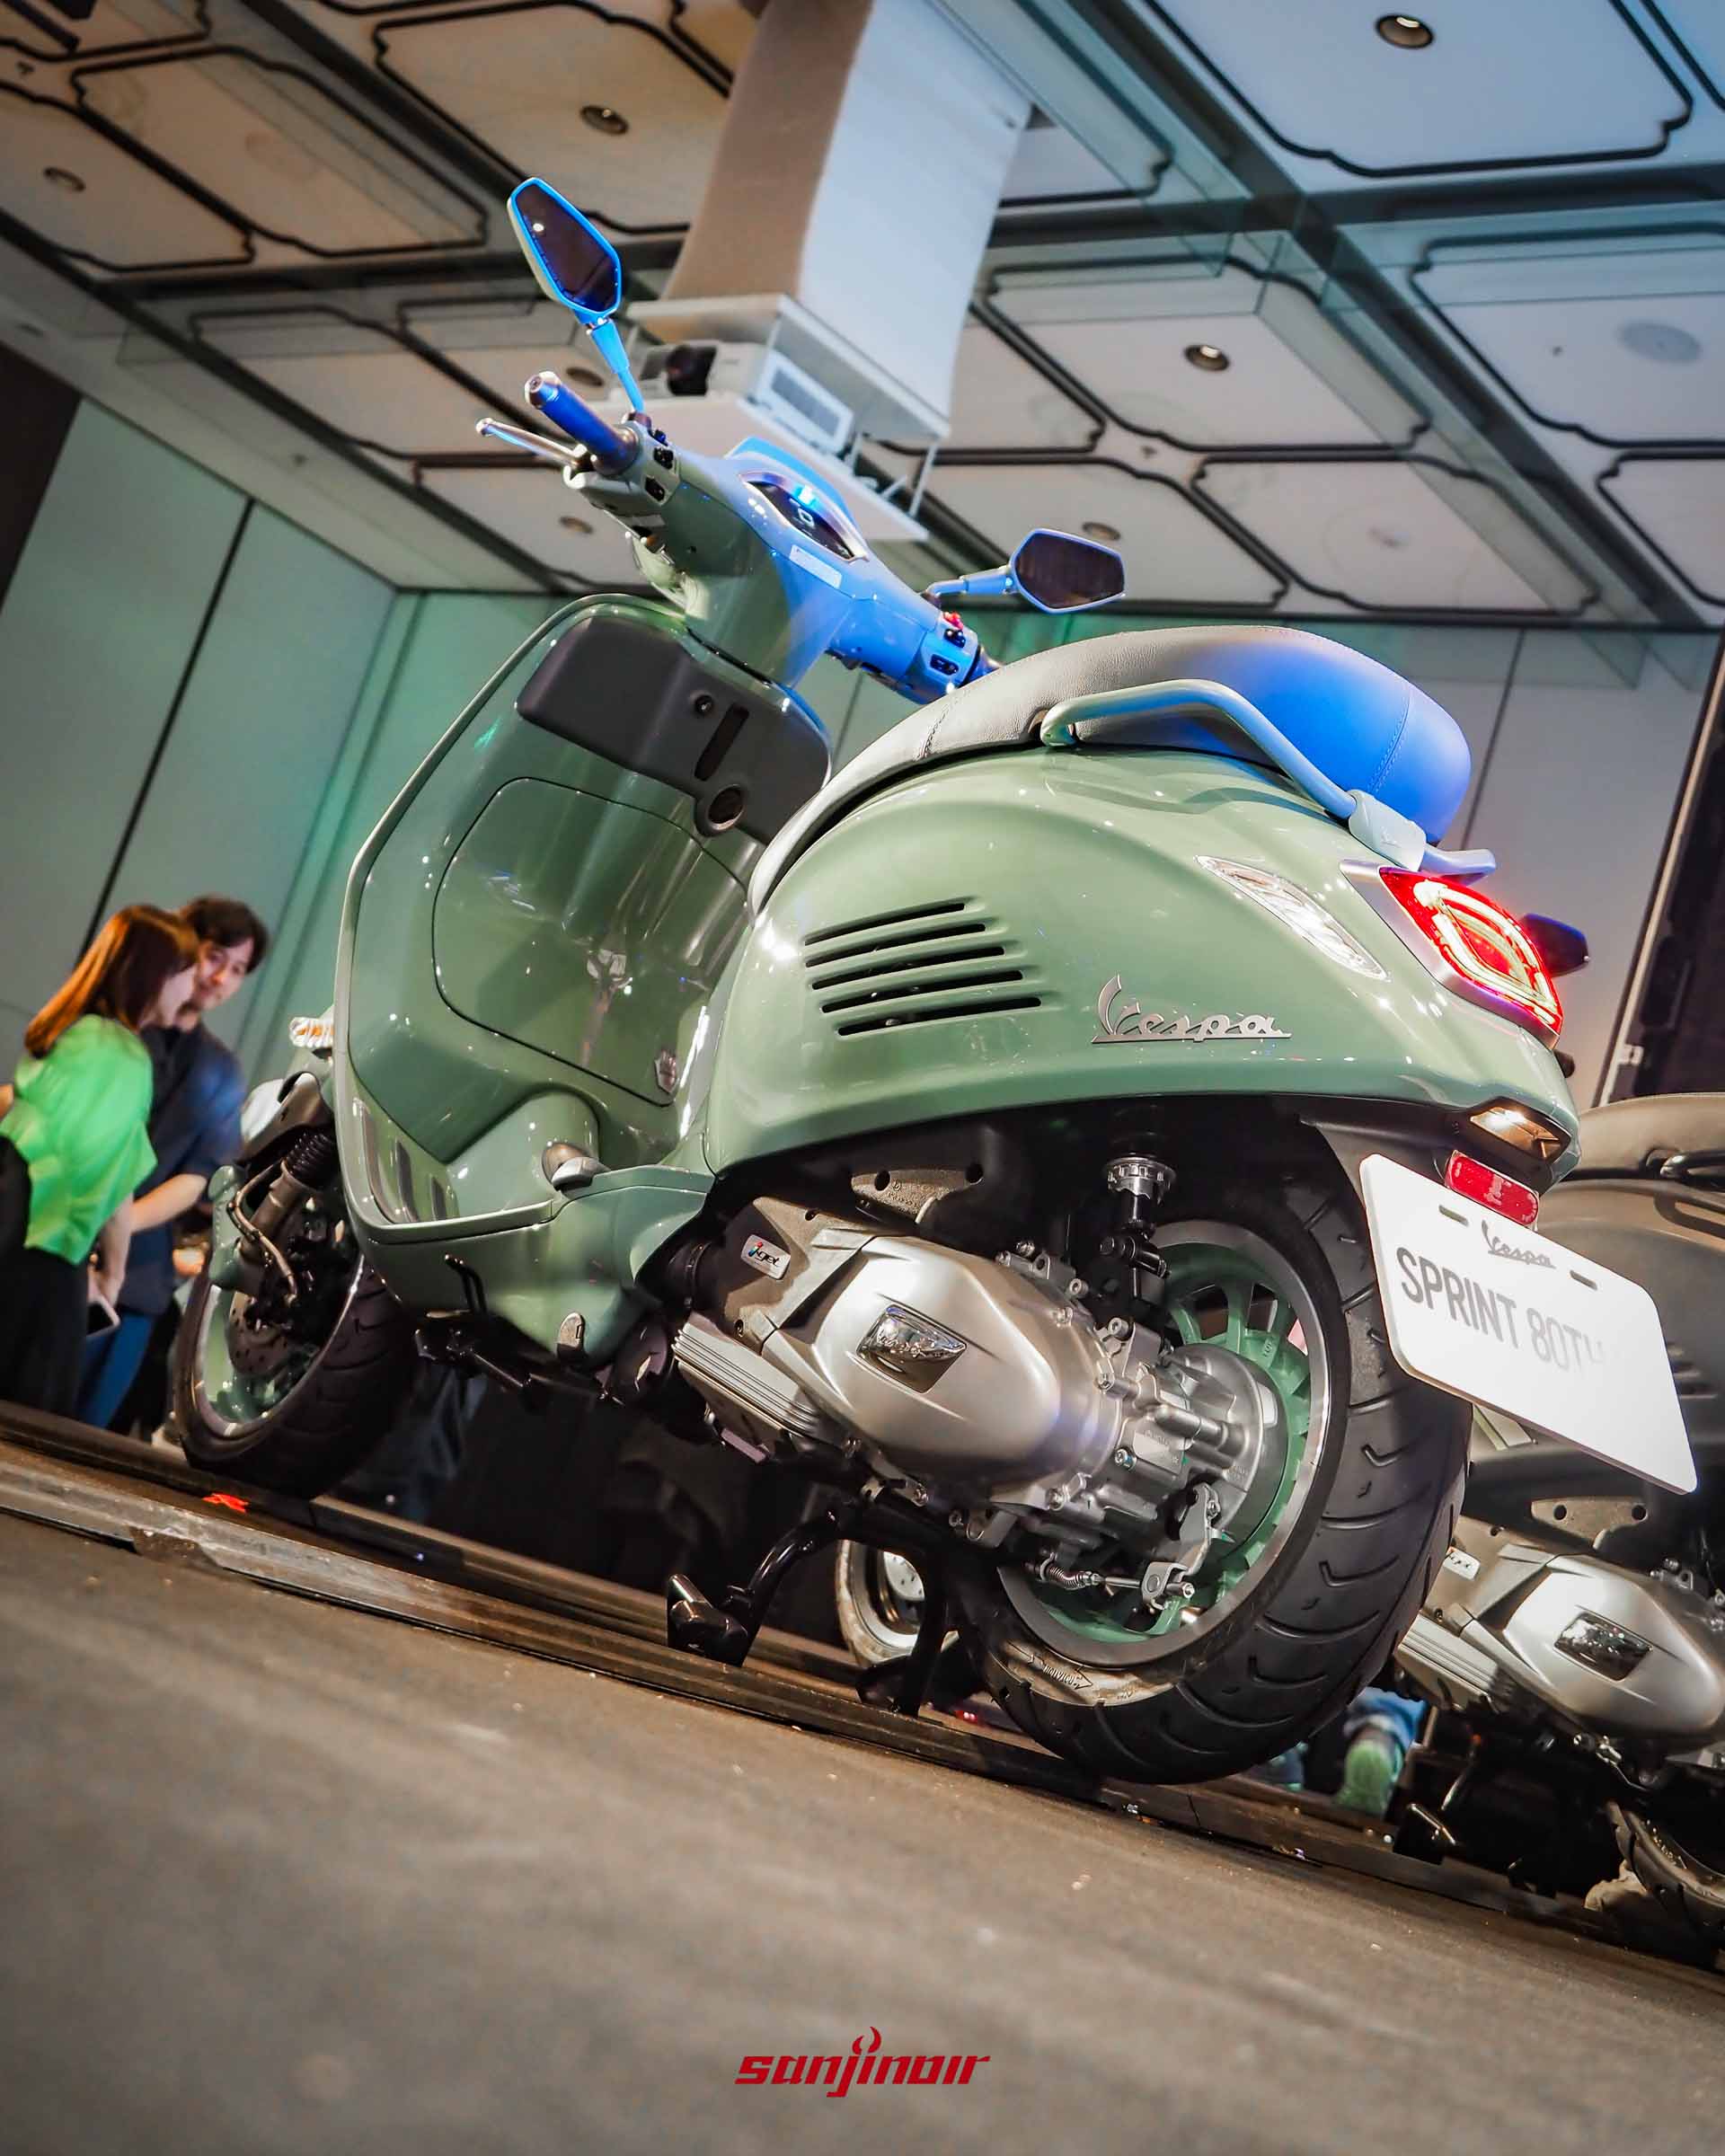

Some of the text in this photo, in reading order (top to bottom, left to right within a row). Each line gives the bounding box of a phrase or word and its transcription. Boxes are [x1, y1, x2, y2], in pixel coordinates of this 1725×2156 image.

[1092, 974, 1292, 1044] Vespa
[1482, 1220, 1556, 1268] Vespa
[1396, 1247, 1519, 1349] SPRINT
